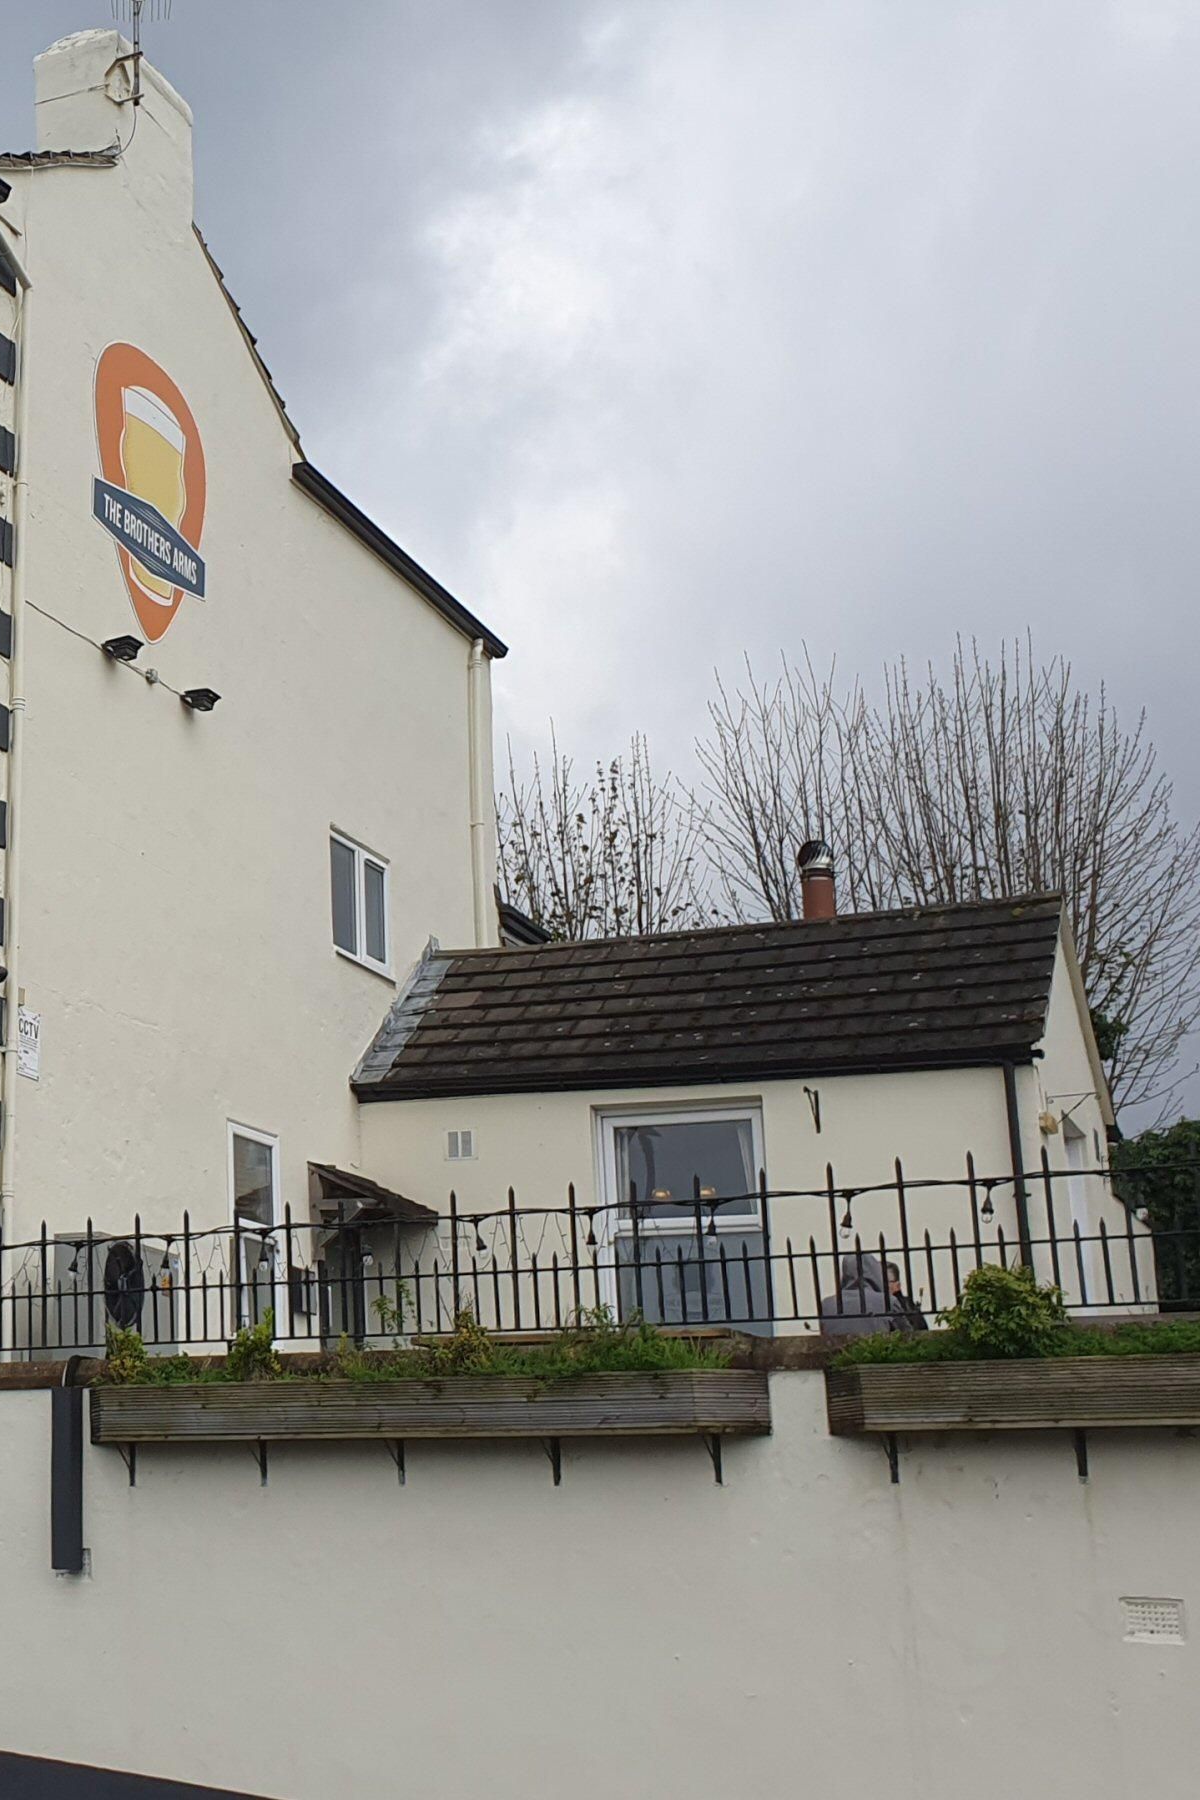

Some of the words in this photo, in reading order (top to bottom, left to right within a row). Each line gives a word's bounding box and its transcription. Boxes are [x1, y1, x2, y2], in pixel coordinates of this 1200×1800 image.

[104, 493, 123, 528] THE
[123, 509, 171, 564] BROTHERS
[172, 547, 197, 585] ARMS
[18, 1017, 40, 1040] CCTV
